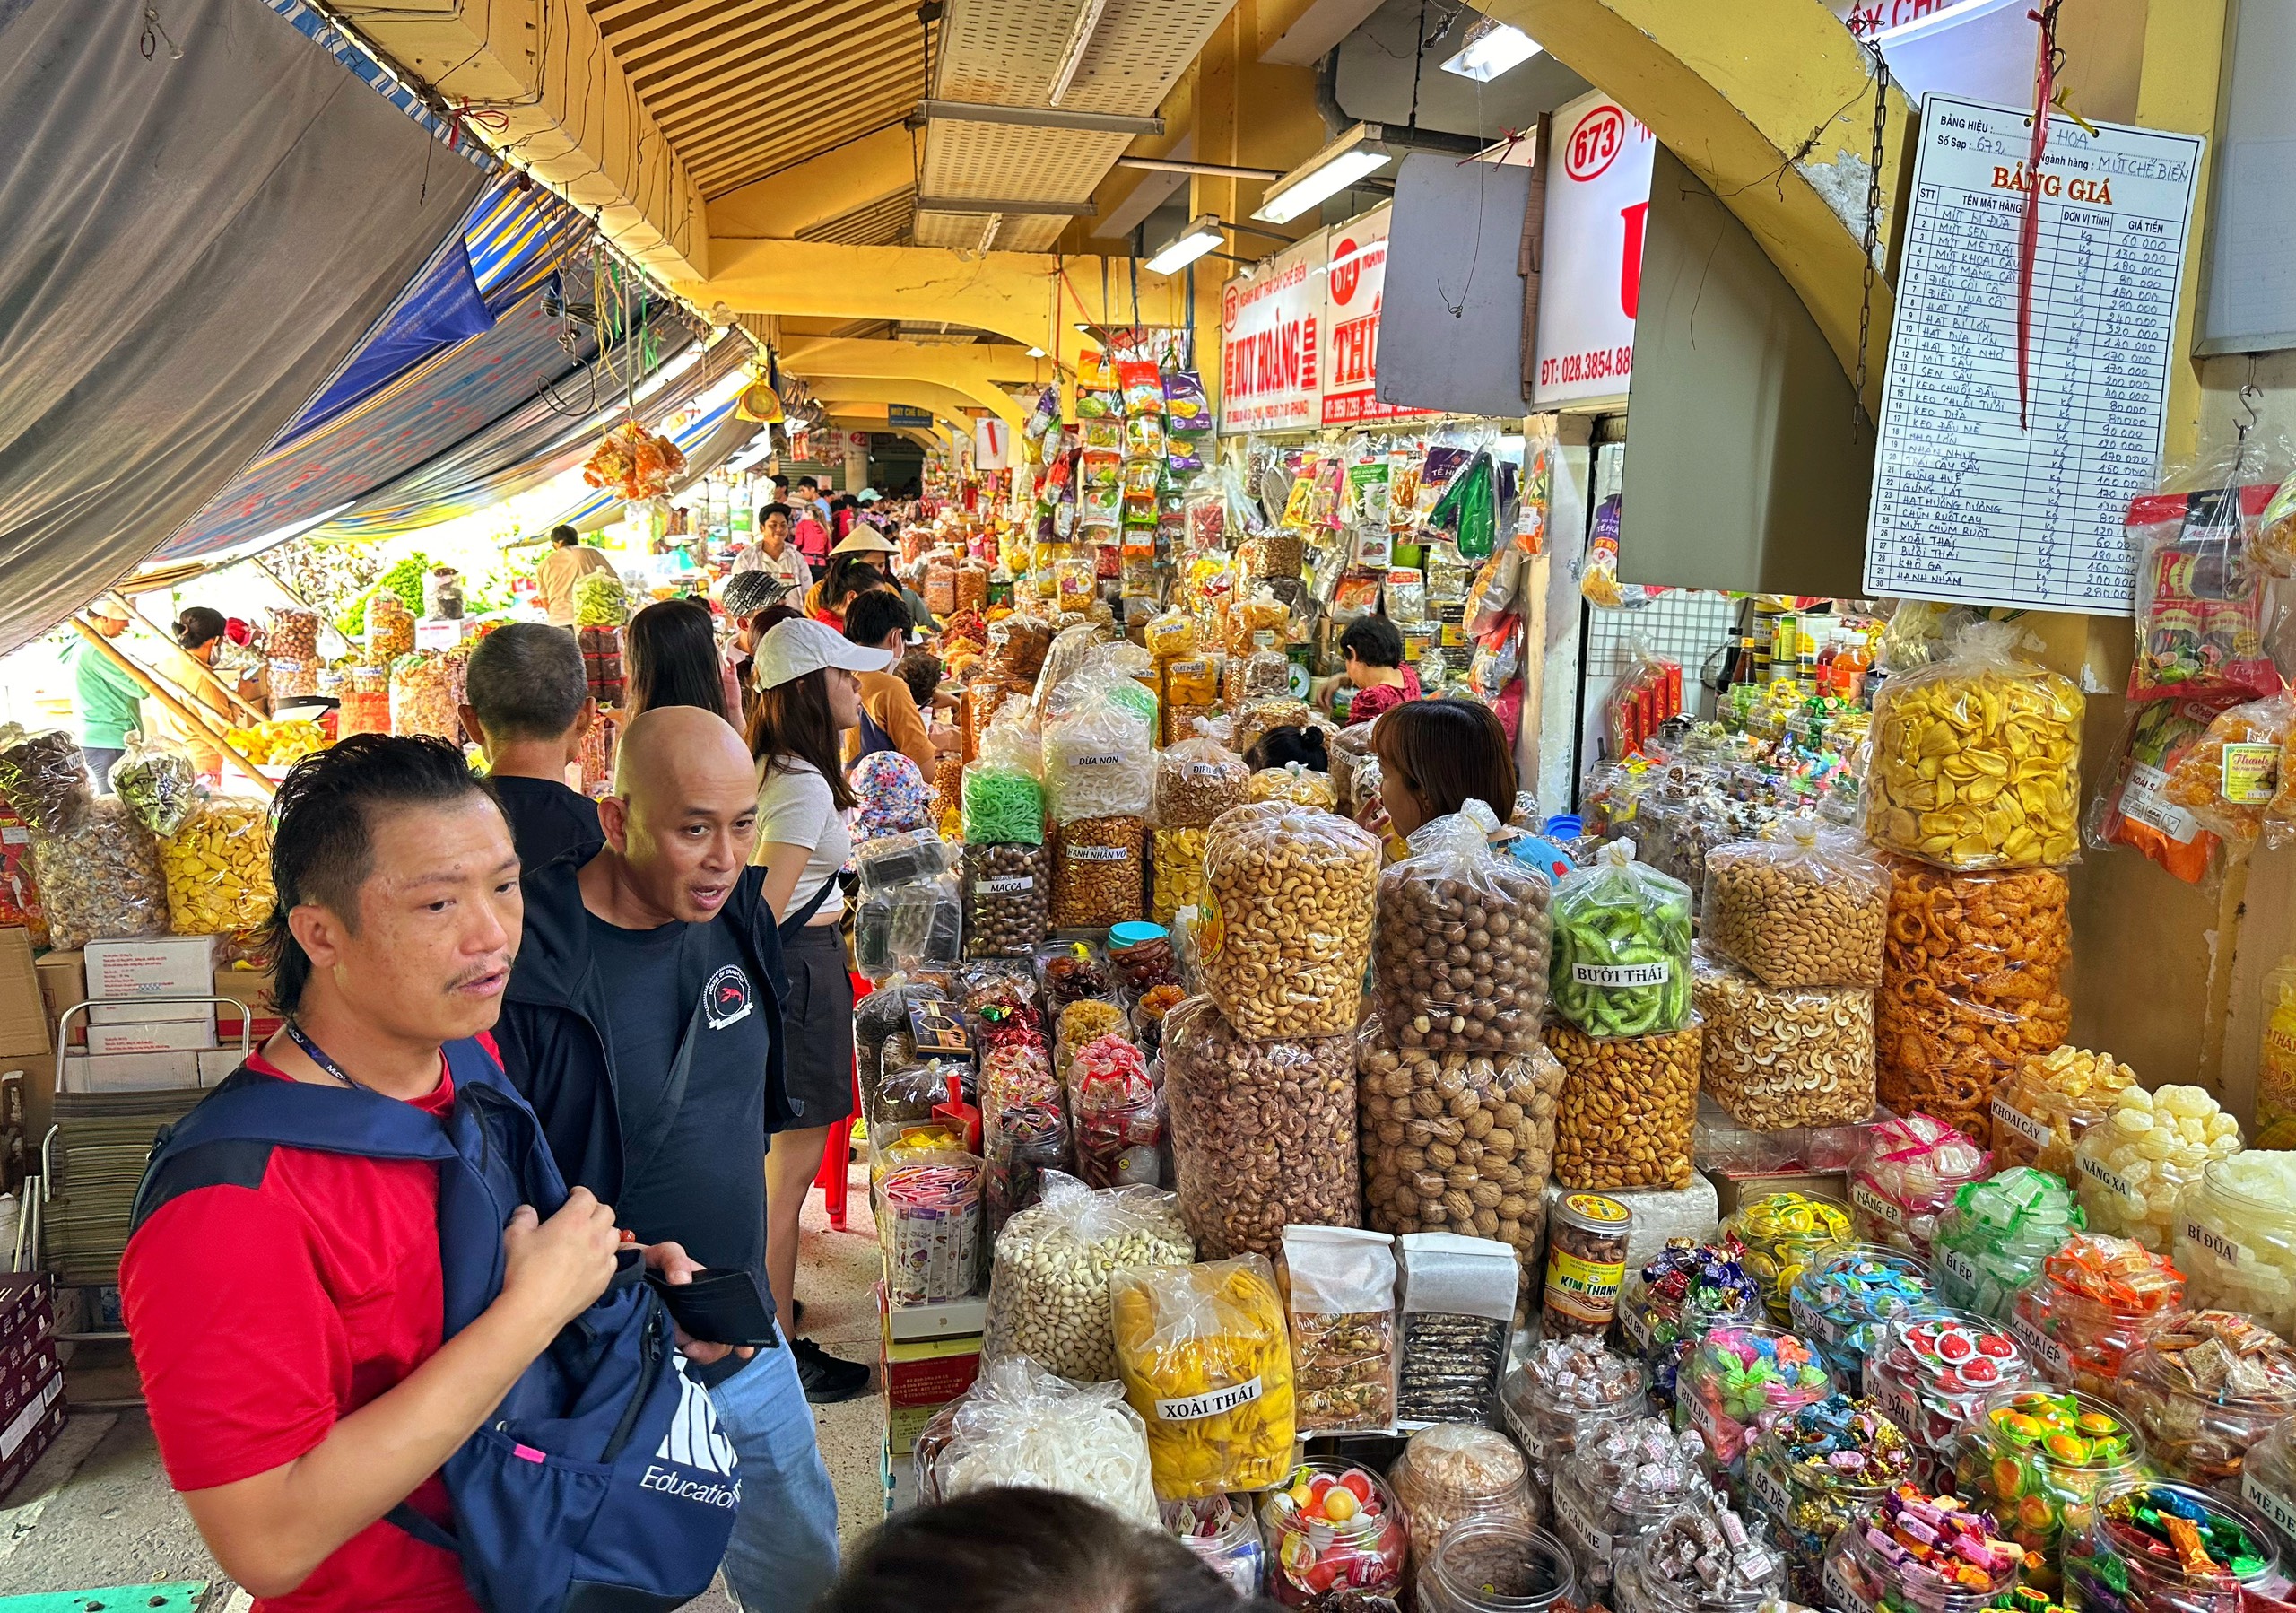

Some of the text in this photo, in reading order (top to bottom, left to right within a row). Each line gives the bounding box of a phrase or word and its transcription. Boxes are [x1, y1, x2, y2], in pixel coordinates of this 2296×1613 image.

[1940, 111, 1965, 128] BẢNG
[1967, 118, 1988, 134] HIỆU
[1574, 117, 1616, 170] 673
[1937, 134, 1949, 145] Số
[1950, 137, 1967, 150] Sạp
[1976, 135, 2005, 154] 672
[2067, 157, 2089, 170] hàng
[2068, 178, 2113, 205] GIÁ
[1919, 188, 2163, 233] STT TÊN MẶT HÀNG ĐƠN VỊ TÍNH GIÁ TIỀN
[2121, 234, 2137, 247] 60
[2143, 238, 2167, 251] 000
[2114, 248, 2135, 261] 130
[2143, 252, 2166, 265] 000
[2141, 265, 2162, 277] 000
[2137, 328, 2159, 339] 000
[1235, 307, 1300, 398] HUY HOÀNG
[1901, 350, 1909, 358] 12
[1904, 325, 1912, 333] 10
[2130, 353, 2152, 364] 000
[1541, 358, 1559, 386] ĐT:
[2126, 367, 2148, 377] 000
[1883, 491, 1892, 499] 23
[1882, 516, 1890, 524] 25
[2085, 574, 2108, 585] 200
[1078, 755, 1119, 766] DỪA NON
[991, 883, 1022, 892] MACCA
[1577, 964, 1662, 982] BƯỞI THÁI
[1991, 1103, 2040, 1140] KHOAI CÂY
[2187, 1221, 2233, 1260] BÍ ĐŨA
[1561, 1275, 1583, 1291] KIM
[1633, 1320, 1645, 1339] BH
[2012, 1321, 2047, 1357] KHOAI
[1165, 1386, 1254, 1417] XOÀI THÁI
[1681, 1389, 1693, 1407] BH
[1888, 1395, 1909, 1425] DÂU
[1507, 1409, 1540, 1454] CHUA CAY
[2249, 1485, 2271, 1510] MÈ
[1584, 1528, 1600, 1549] ME
